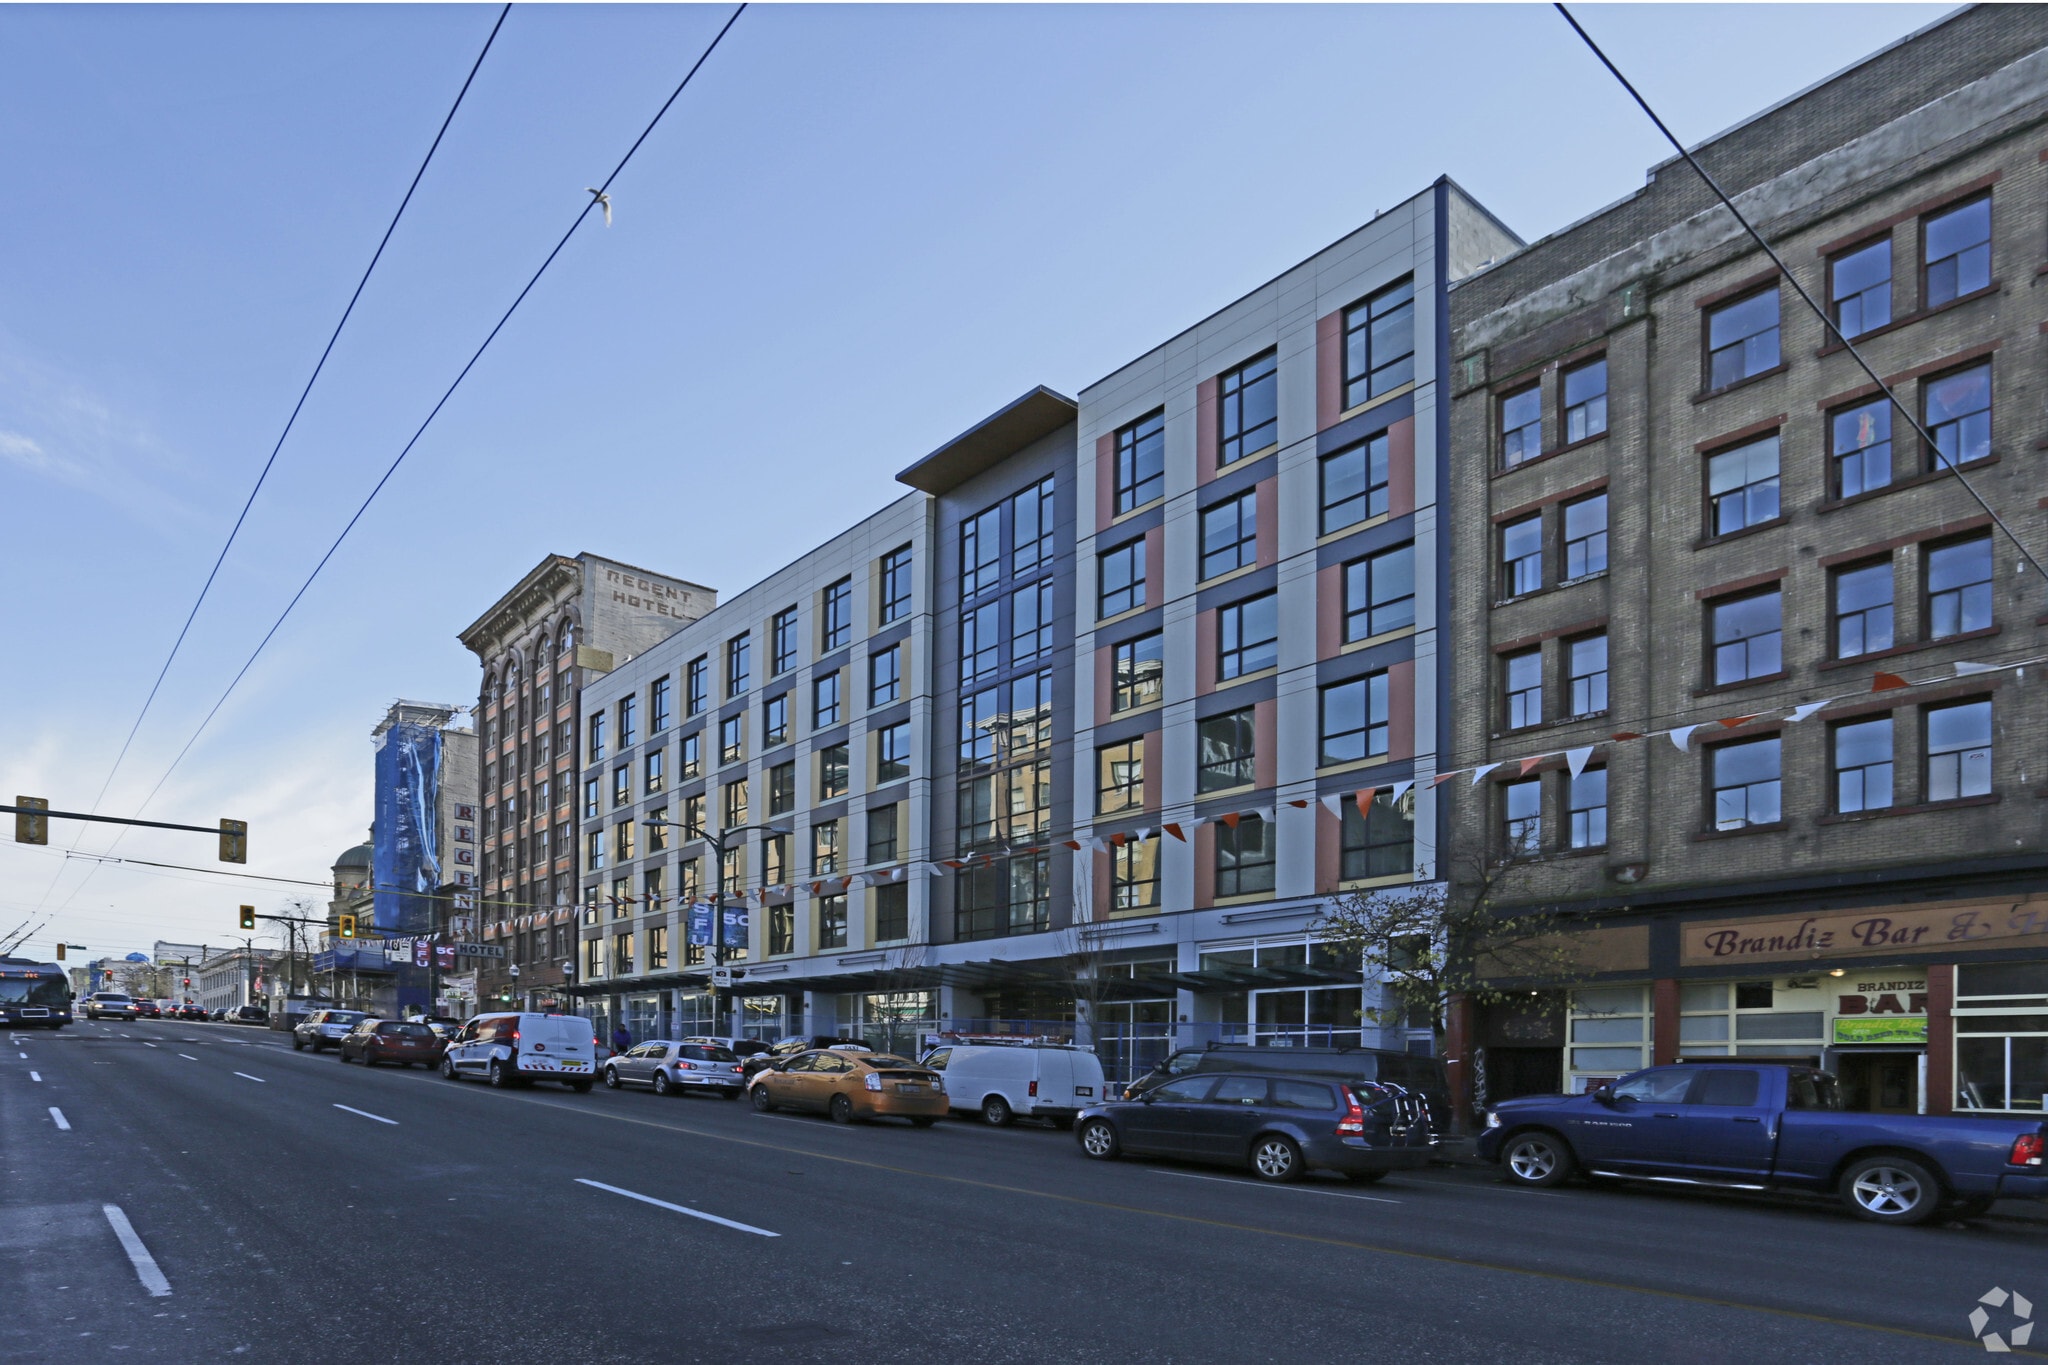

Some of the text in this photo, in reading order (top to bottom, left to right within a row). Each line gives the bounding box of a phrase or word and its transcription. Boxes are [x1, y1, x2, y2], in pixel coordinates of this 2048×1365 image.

[606, 569, 692, 603] REGENT
[613, 590, 683, 620] HOTEL
[458, 806, 472, 931] REGENT
[459, 944, 502, 958] HOTEL
[1704, 917, 1835, 956] Brandiz
[1851, 918, 1929, 947] Bar
[1857, 981, 1925, 992] BRANDIZ
